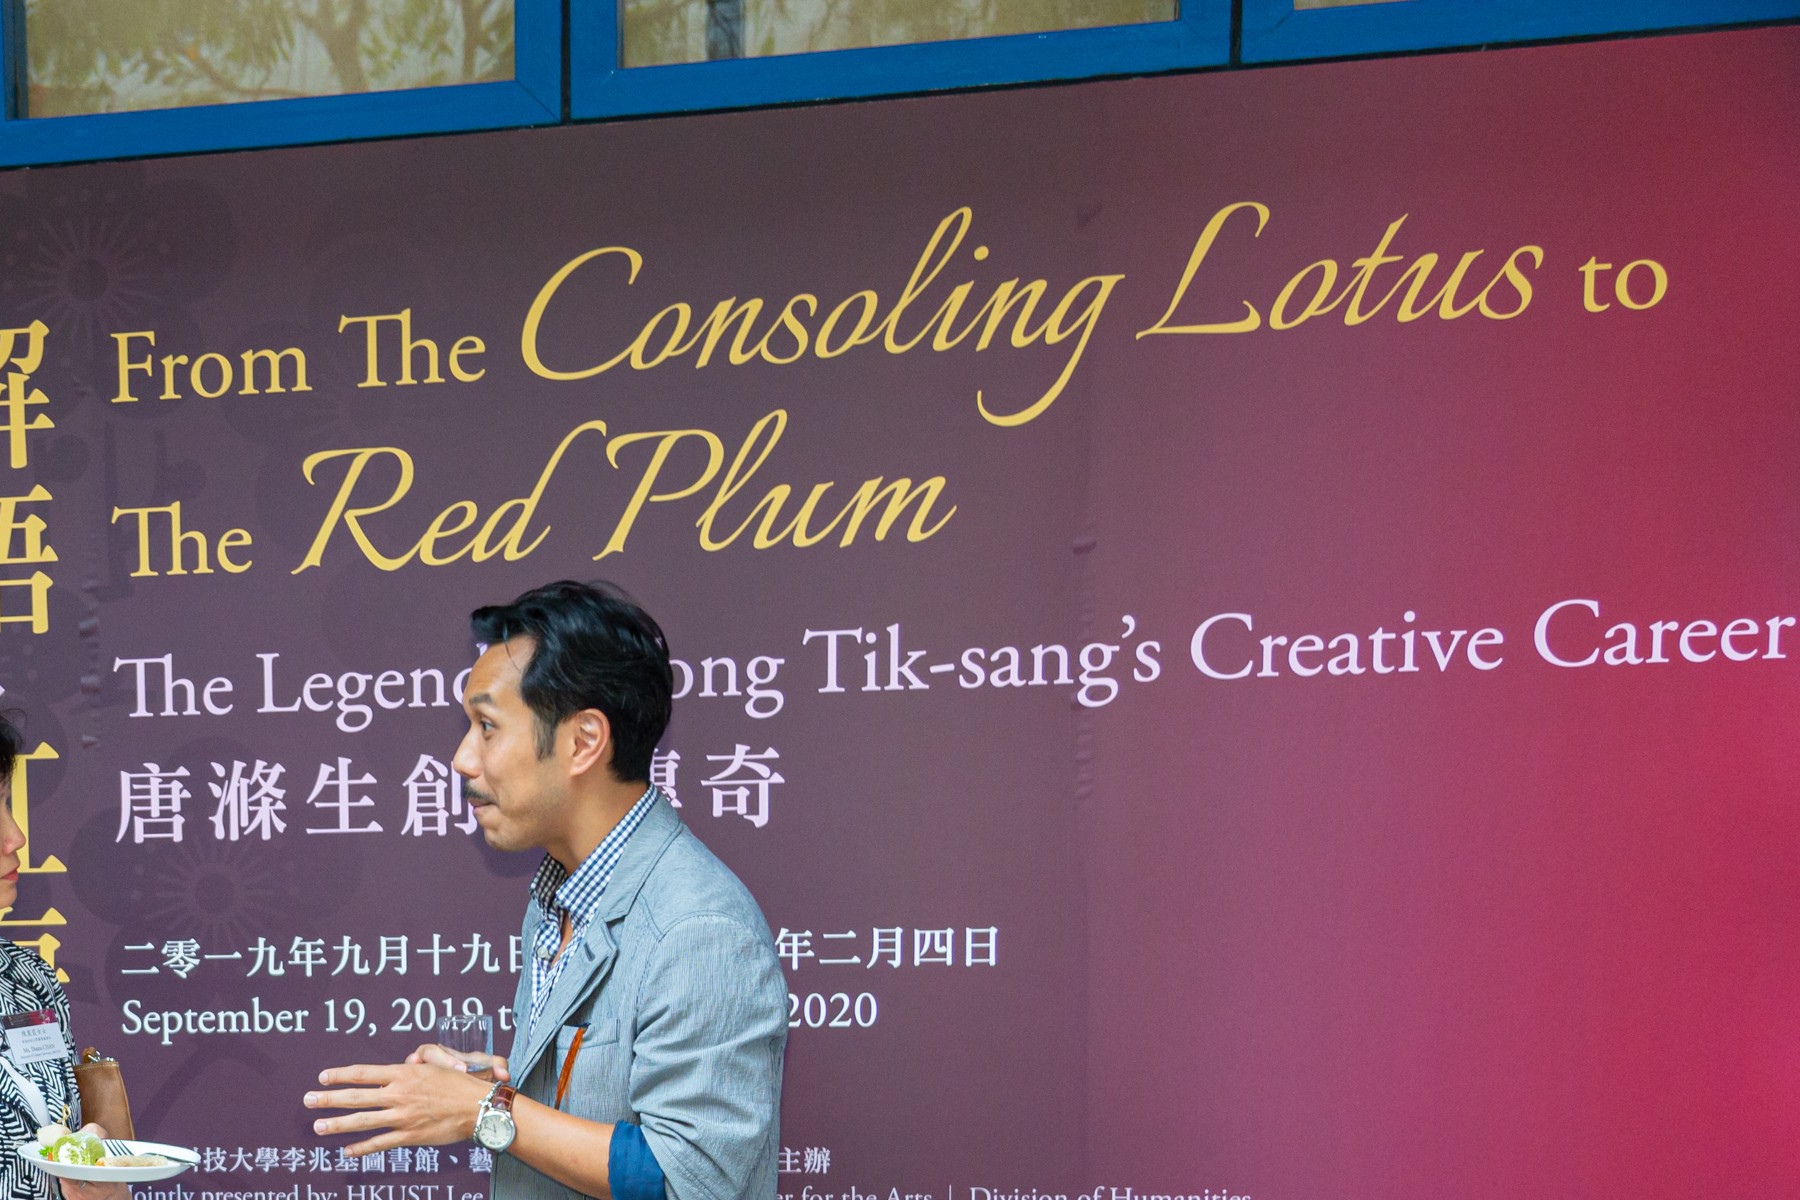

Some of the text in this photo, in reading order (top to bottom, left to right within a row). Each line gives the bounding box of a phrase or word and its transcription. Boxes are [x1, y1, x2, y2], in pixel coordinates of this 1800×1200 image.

[111, 201, 1669, 427] From The Consoling Lotus to
[111, 409, 957, 577] The Red Plum
[114, 653, 234, 718] The
[668, 650, 785, 719] ong
[803, 615, 1161, 708] Tik-sang’s
[1190, 611, 1504, 680] Creative
[1534, 600, 1798, 668] Career
[122, 996, 310, 1046] September
[324, 998, 377, 1037] 19,
[497, 1004, 517, 1031] t
[788, 992, 878, 1028] 2020
